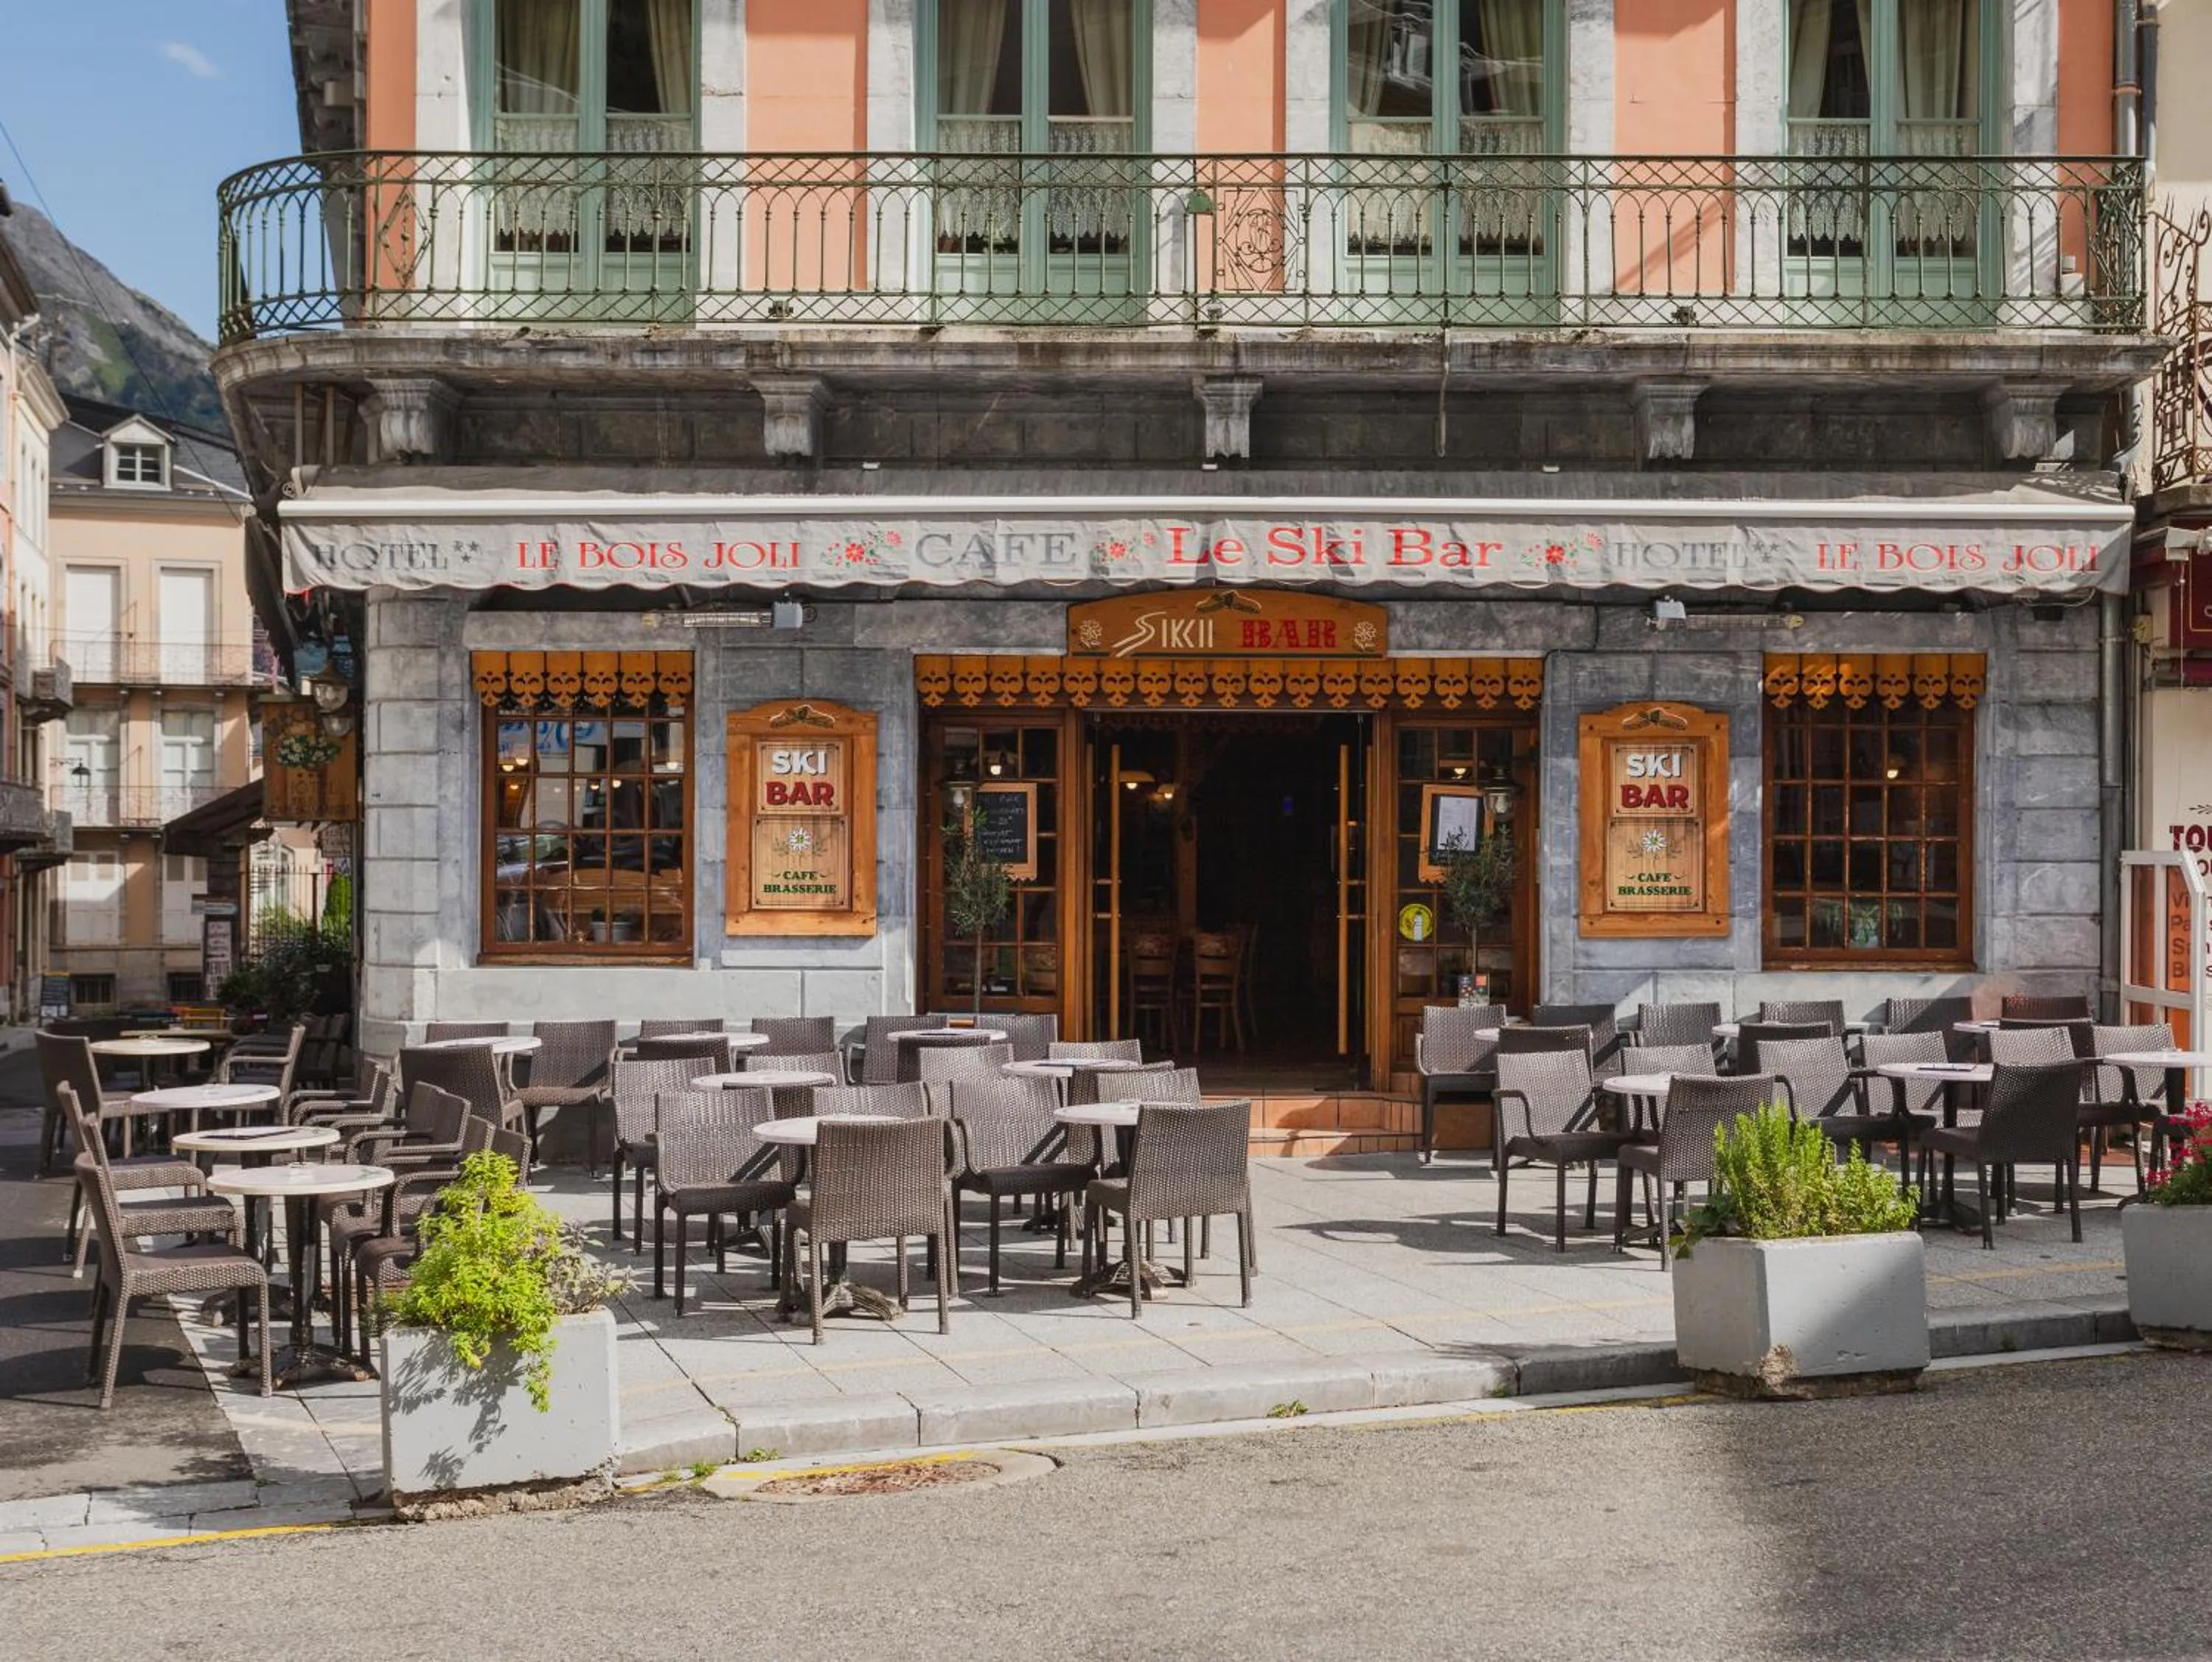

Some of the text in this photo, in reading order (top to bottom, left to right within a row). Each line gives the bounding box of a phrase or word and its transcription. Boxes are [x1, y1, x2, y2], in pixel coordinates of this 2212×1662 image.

[310, 542, 448, 571] HOTEL
[516, 541, 801, 569] LE BOIS JOLI
[915, 532, 1077, 565] CAFE
[1166, 526, 1503, 566] Le Ski Bar
[1615, 542, 1749, 570] HOTEL
[1817, 542, 2101, 572] LE BOIS JOLI
[1240, 619, 1339, 648] BAR
[772, 749, 827, 775] SKI
[1627, 753, 1682, 778] SKI
[766, 781, 835, 806] BAR
[1621, 784, 1689, 809] BAR
[782, 871, 817, 880] CAFE
[1638, 873, 1671, 883] CAFE
[763, 885, 837, 894] BRASSERIE
[1618, 886, 1692, 895] BRASSERIE
